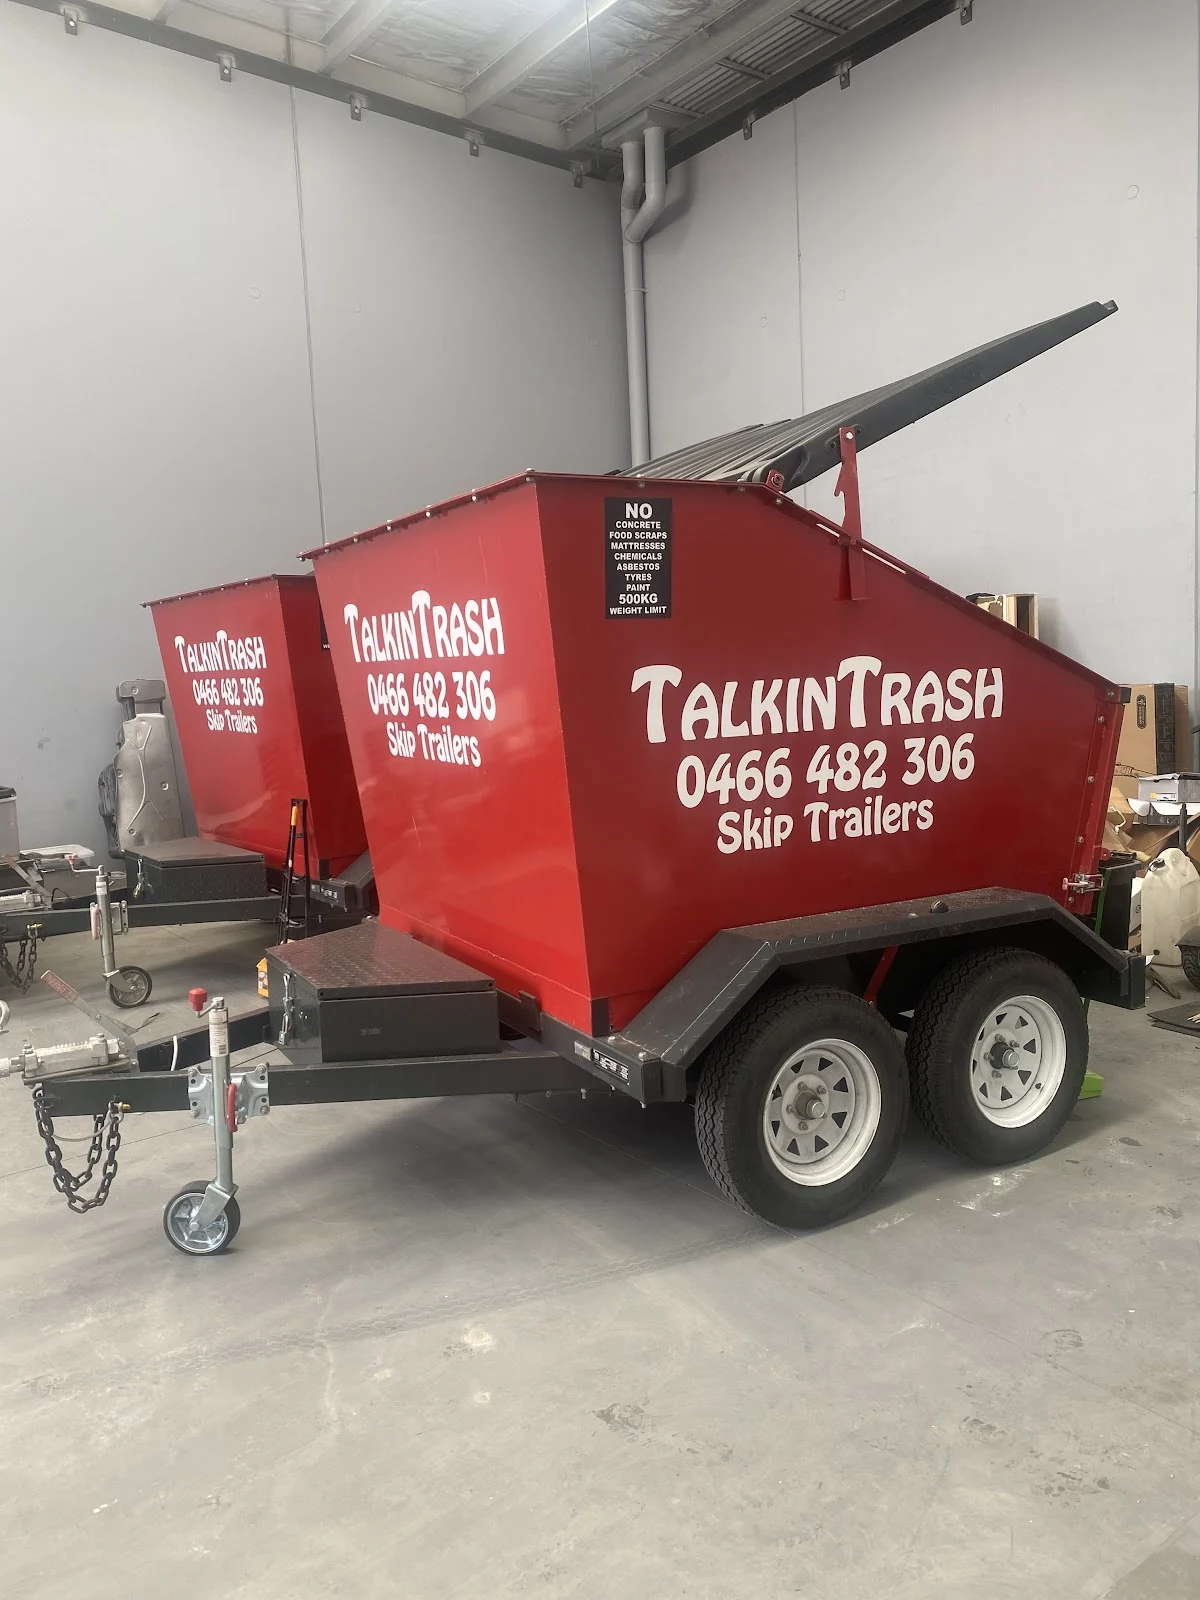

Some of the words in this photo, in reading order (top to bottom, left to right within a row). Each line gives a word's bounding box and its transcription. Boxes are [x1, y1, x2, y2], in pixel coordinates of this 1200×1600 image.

[625, 502, 653, 519] NO
[615, 520, 662, 529] CONCRETE
[609, 531, 633, 540] FOOD
[634, 531, 668, 540] SCRAPS
[610, 541, 666, 550] MATTRESSES
[613, 552, 663, 561] CHEMICALS
[616, 562, 661, 571] ASBESTOS
[624, 573, 653, 582] TYRES
[626, 583, 651, 592] PAINT
[618, 593, 658, 605] 500KG
[609, 606, 643, 615] WEIGHT
[644, 606, 667, 614] LIMIT
[193, 678, 220, 706] 0466
[221, 678, 240, 706] 482
[240, 676, 265, 707] 306
[367, 672, 410, 717] 0466
[413, 671, 450, 719] 482
[452, 669, 497, 722] 306
[206, 709, 224, 731] Skip
[224, 708, 258, 735] Trailers
[387, 721, 416, 758] Skip
[416, 723, 482, 768] Trailers
[676, 747, 793, 809] 0466
[805, 740, 888, 795] 482
[901, 732, 975, 786] 306
[716, 805, 794, 854] Skip
[803, 795, 934, 843] Trailers
